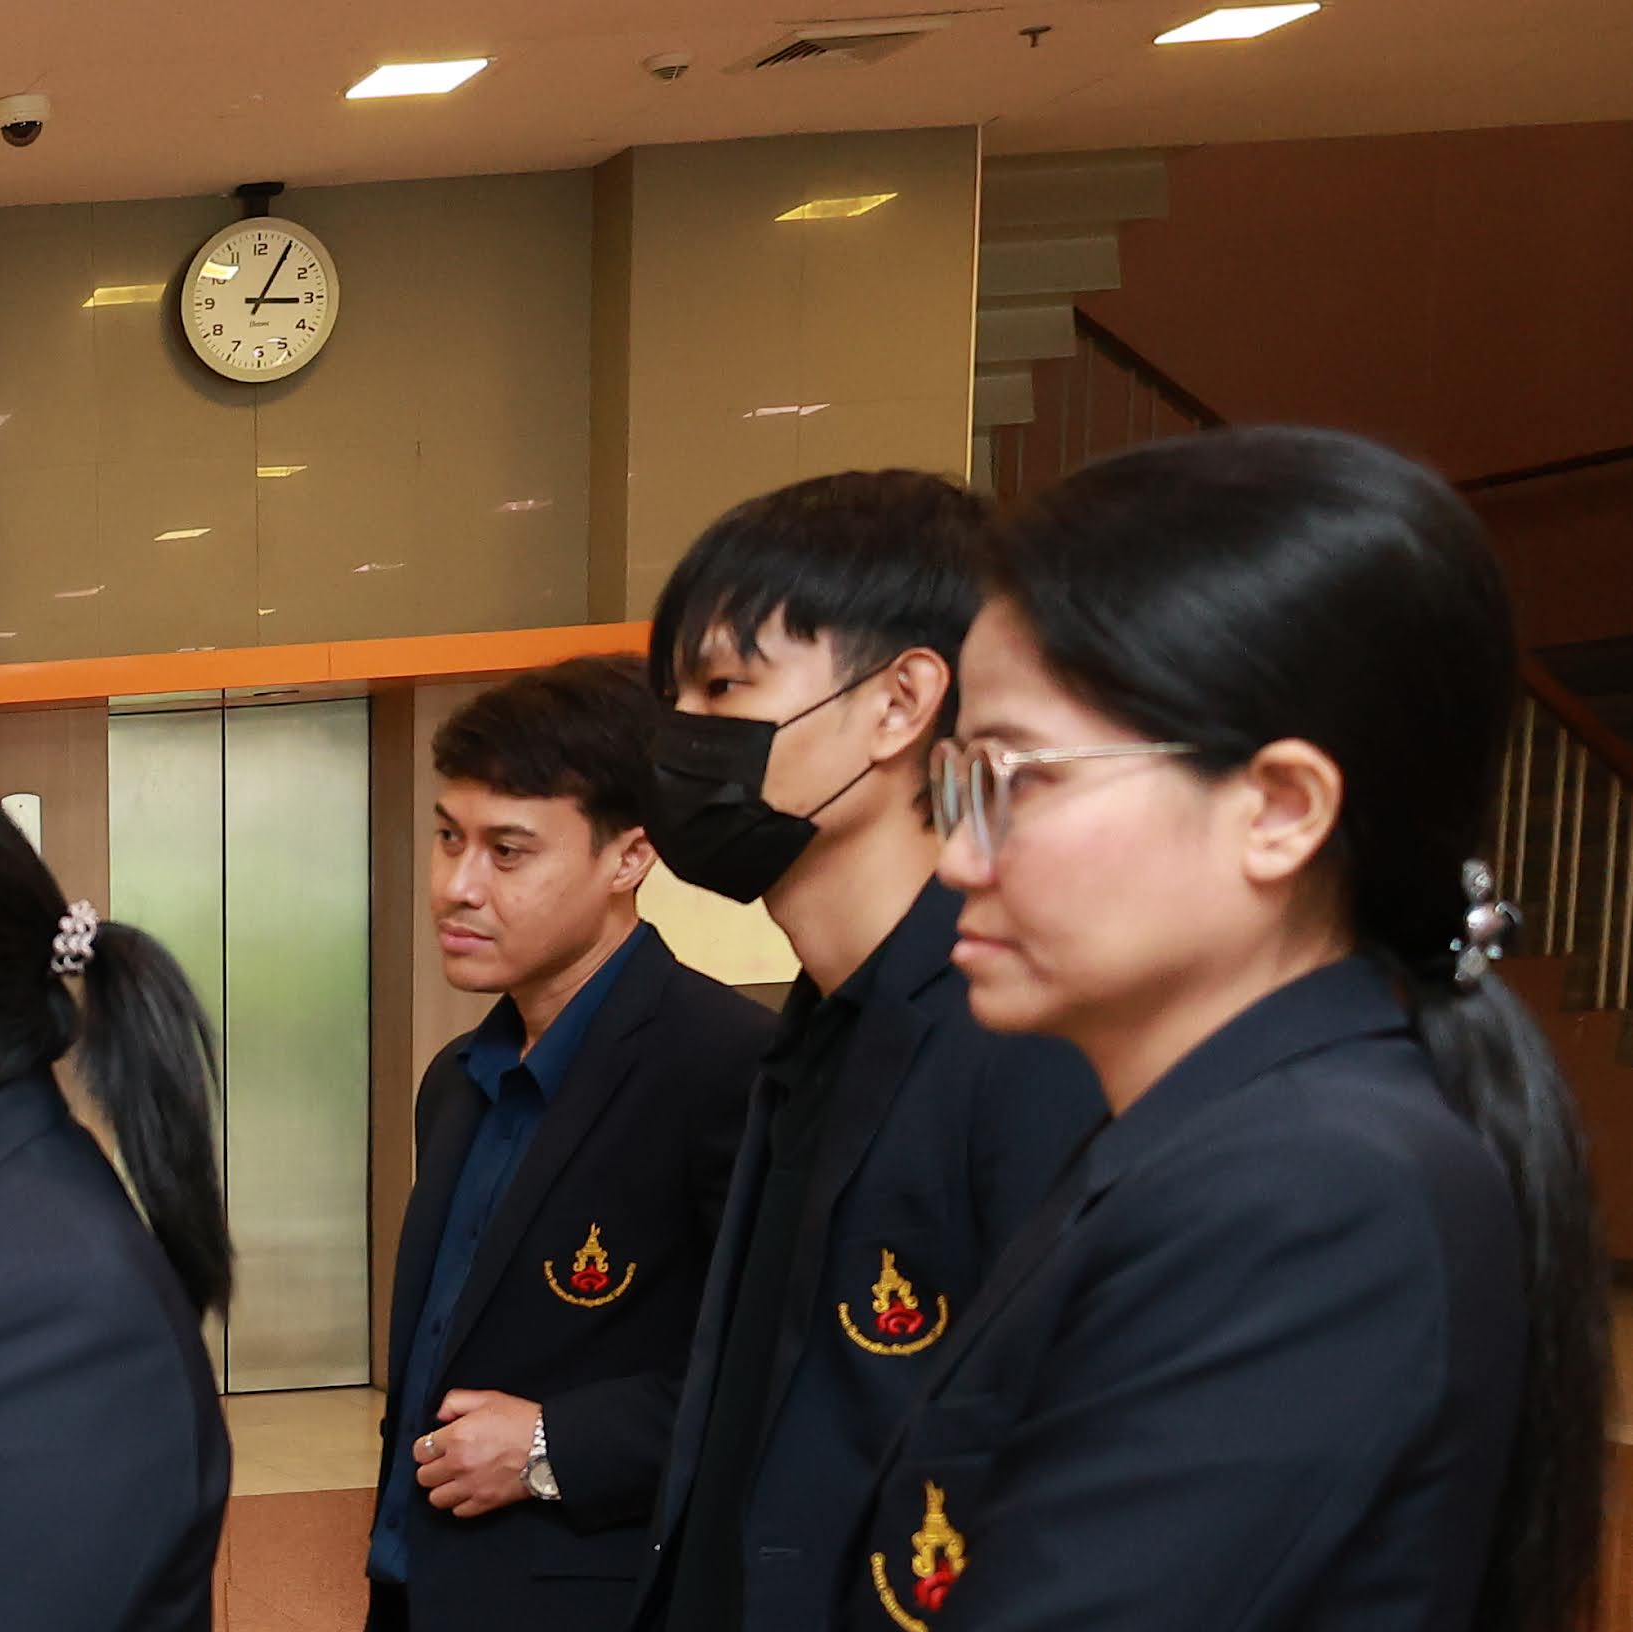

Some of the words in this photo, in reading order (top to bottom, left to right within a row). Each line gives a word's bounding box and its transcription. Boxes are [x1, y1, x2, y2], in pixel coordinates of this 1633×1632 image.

[253, 243, 268, 256] 12
[297, 267, 308, 280] 2
[204, 298, 215, 310] 9
[304, 292, 314, 304] 3
[212, 324, 223, 336] 8
[295, 318, 307, 331] 4
[231, 340, 241, 352] 7
